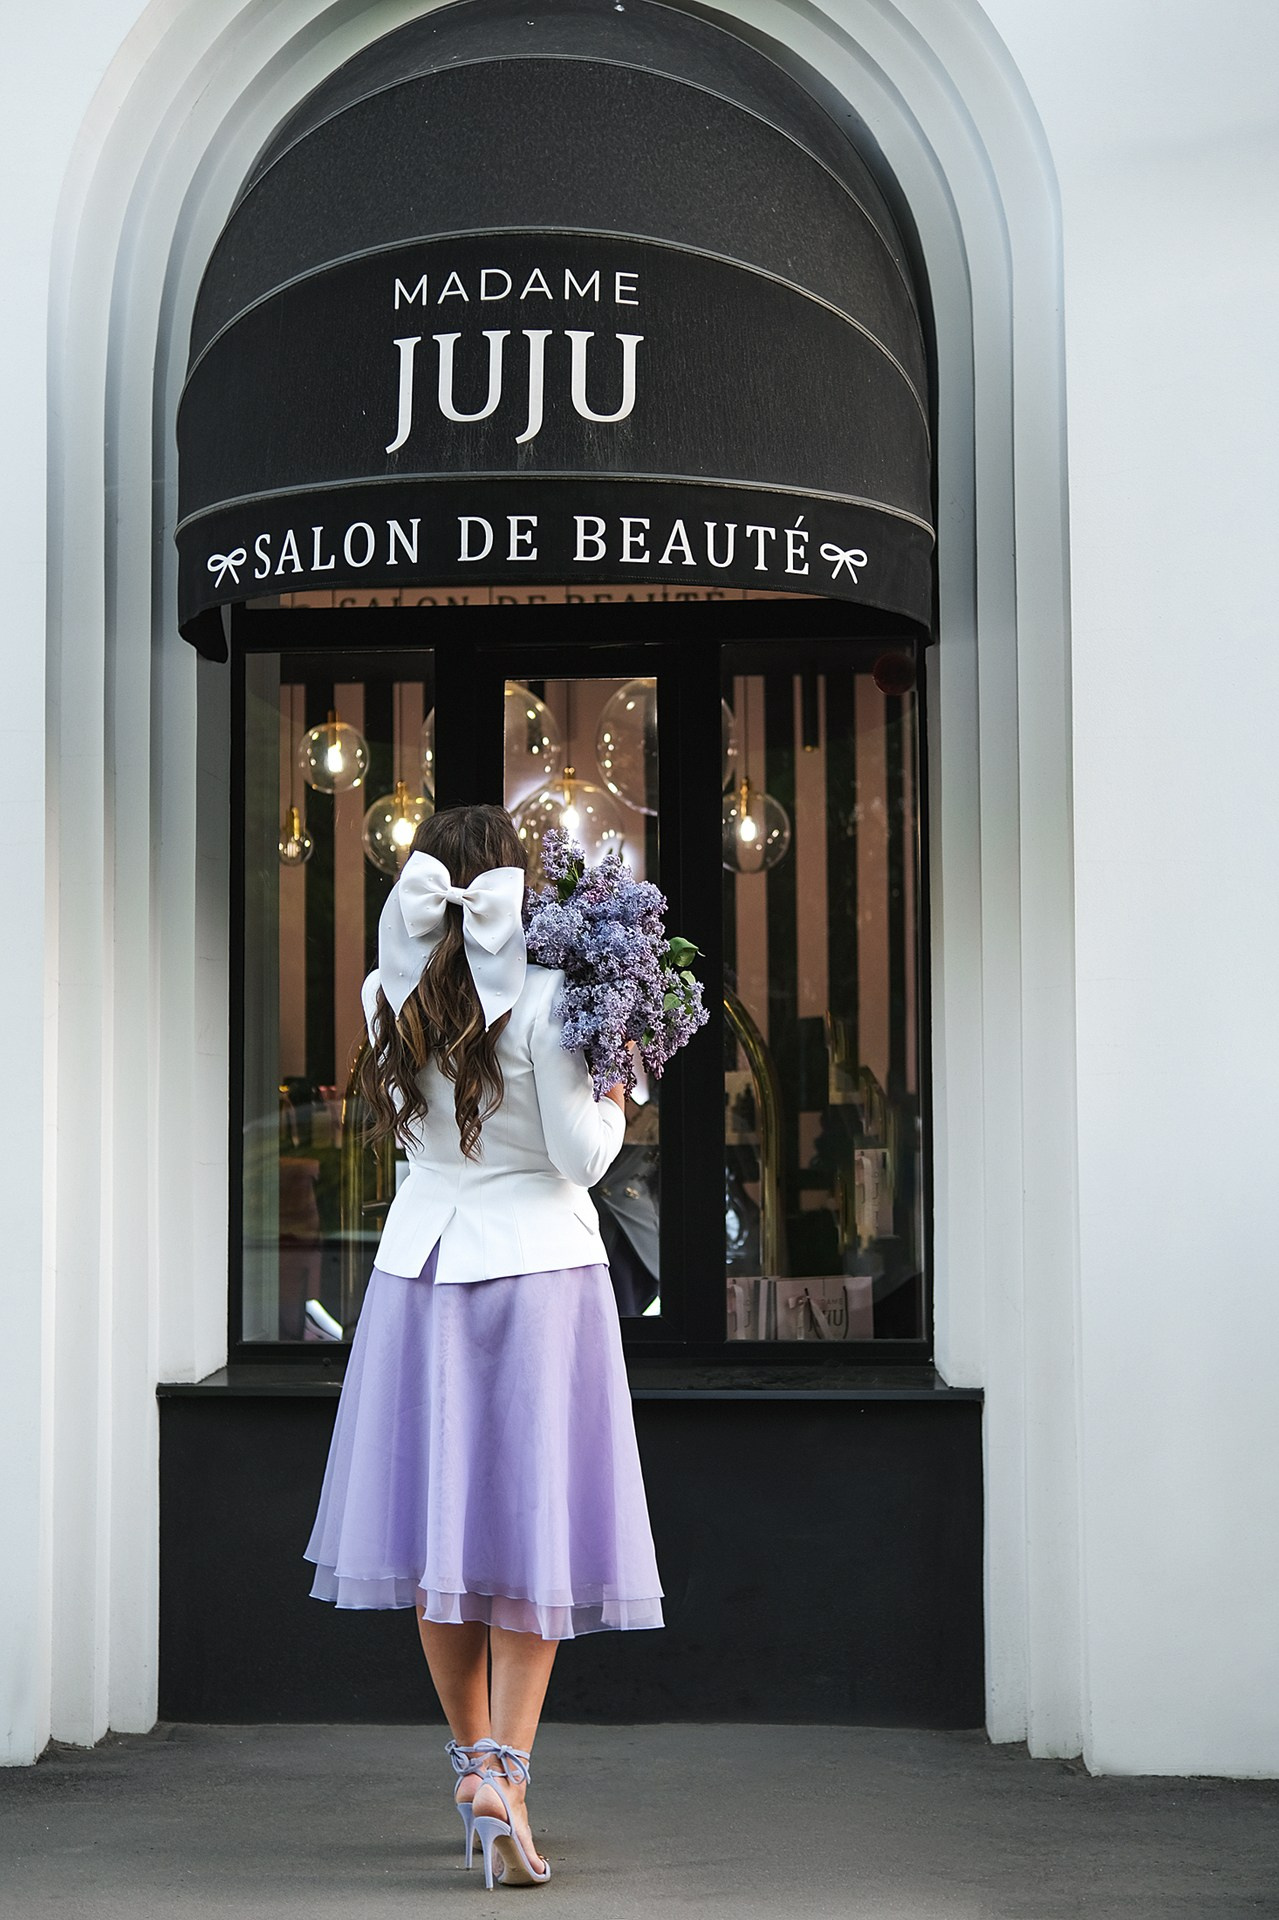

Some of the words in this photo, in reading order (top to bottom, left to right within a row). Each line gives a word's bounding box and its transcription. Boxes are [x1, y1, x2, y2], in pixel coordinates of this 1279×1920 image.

[394, 268, 639, 310] MADAME
[385, 329, 645, 454] JUJU
[254, 518, 421, 579] SALON
[457, 515, 538, 562] DE
[572, 515, 809, 575] BEAUTÉ
